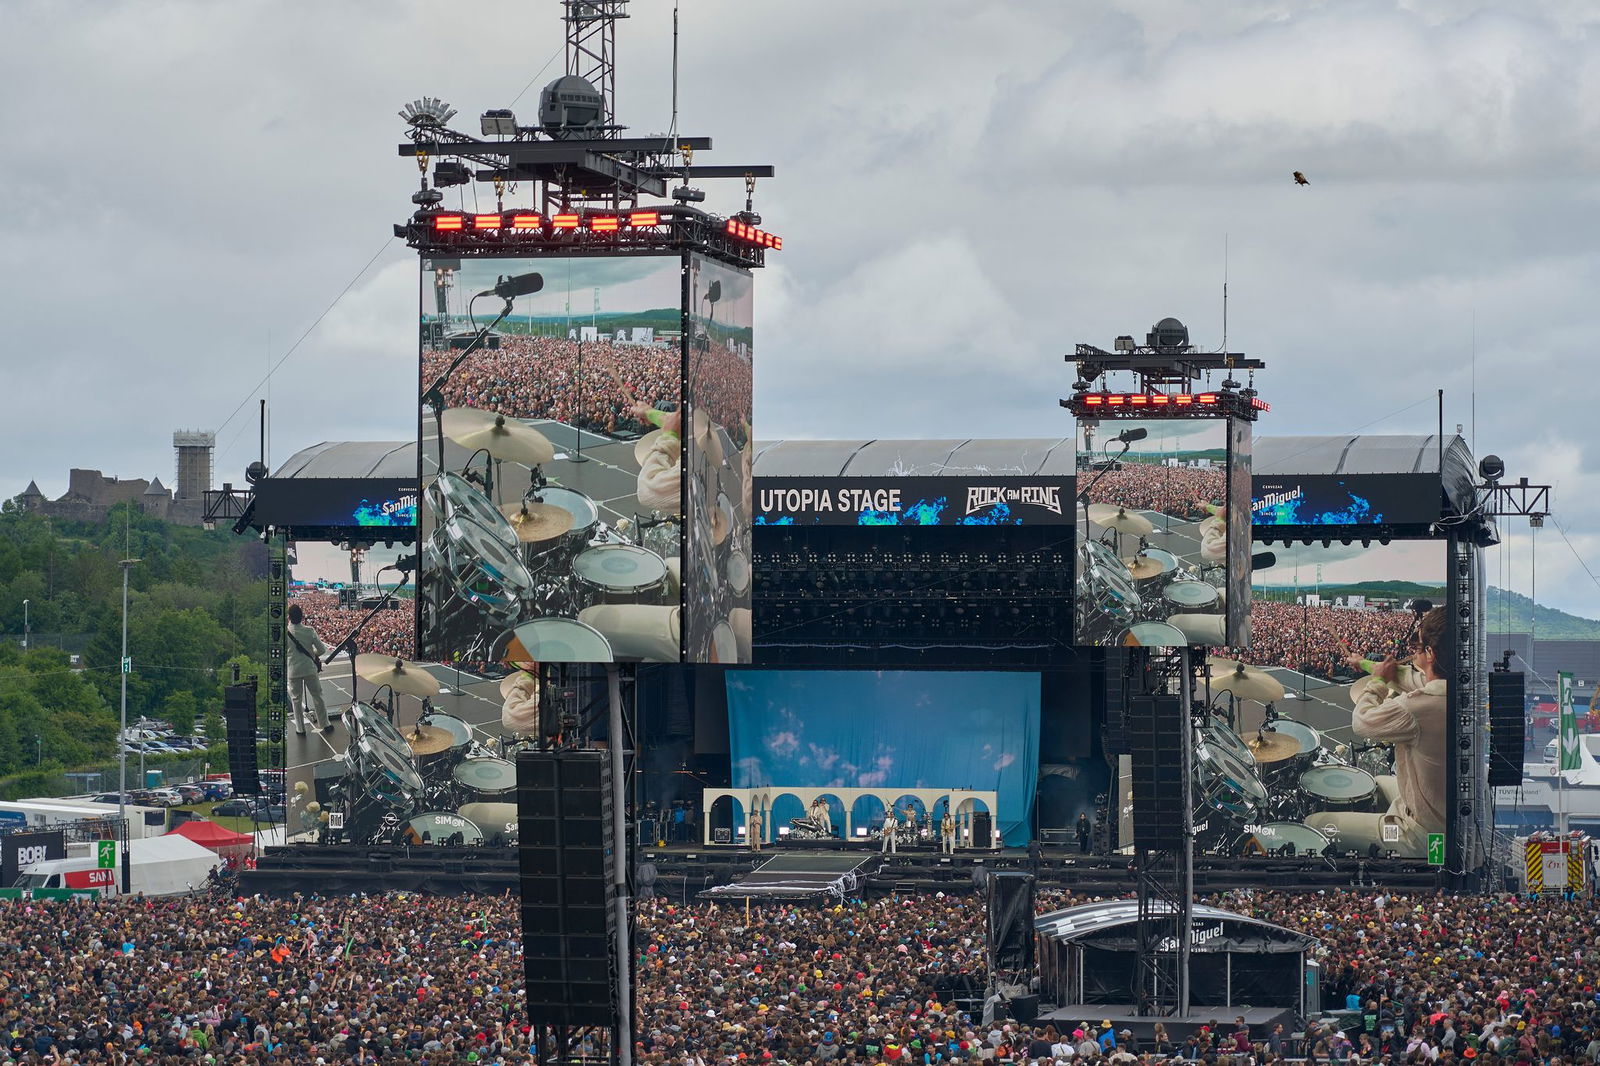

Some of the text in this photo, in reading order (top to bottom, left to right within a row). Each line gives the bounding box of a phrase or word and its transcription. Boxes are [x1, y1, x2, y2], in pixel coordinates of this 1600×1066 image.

[760, 488, 901, 512] UTOPIA STAGE
[966, 486, 1062, 515] ROCK AM RING
[435, 815, 465, 828] SIMON
[1243, 824, 1276, 836] SIMON
[18, 845, 47, 865] BOB!
